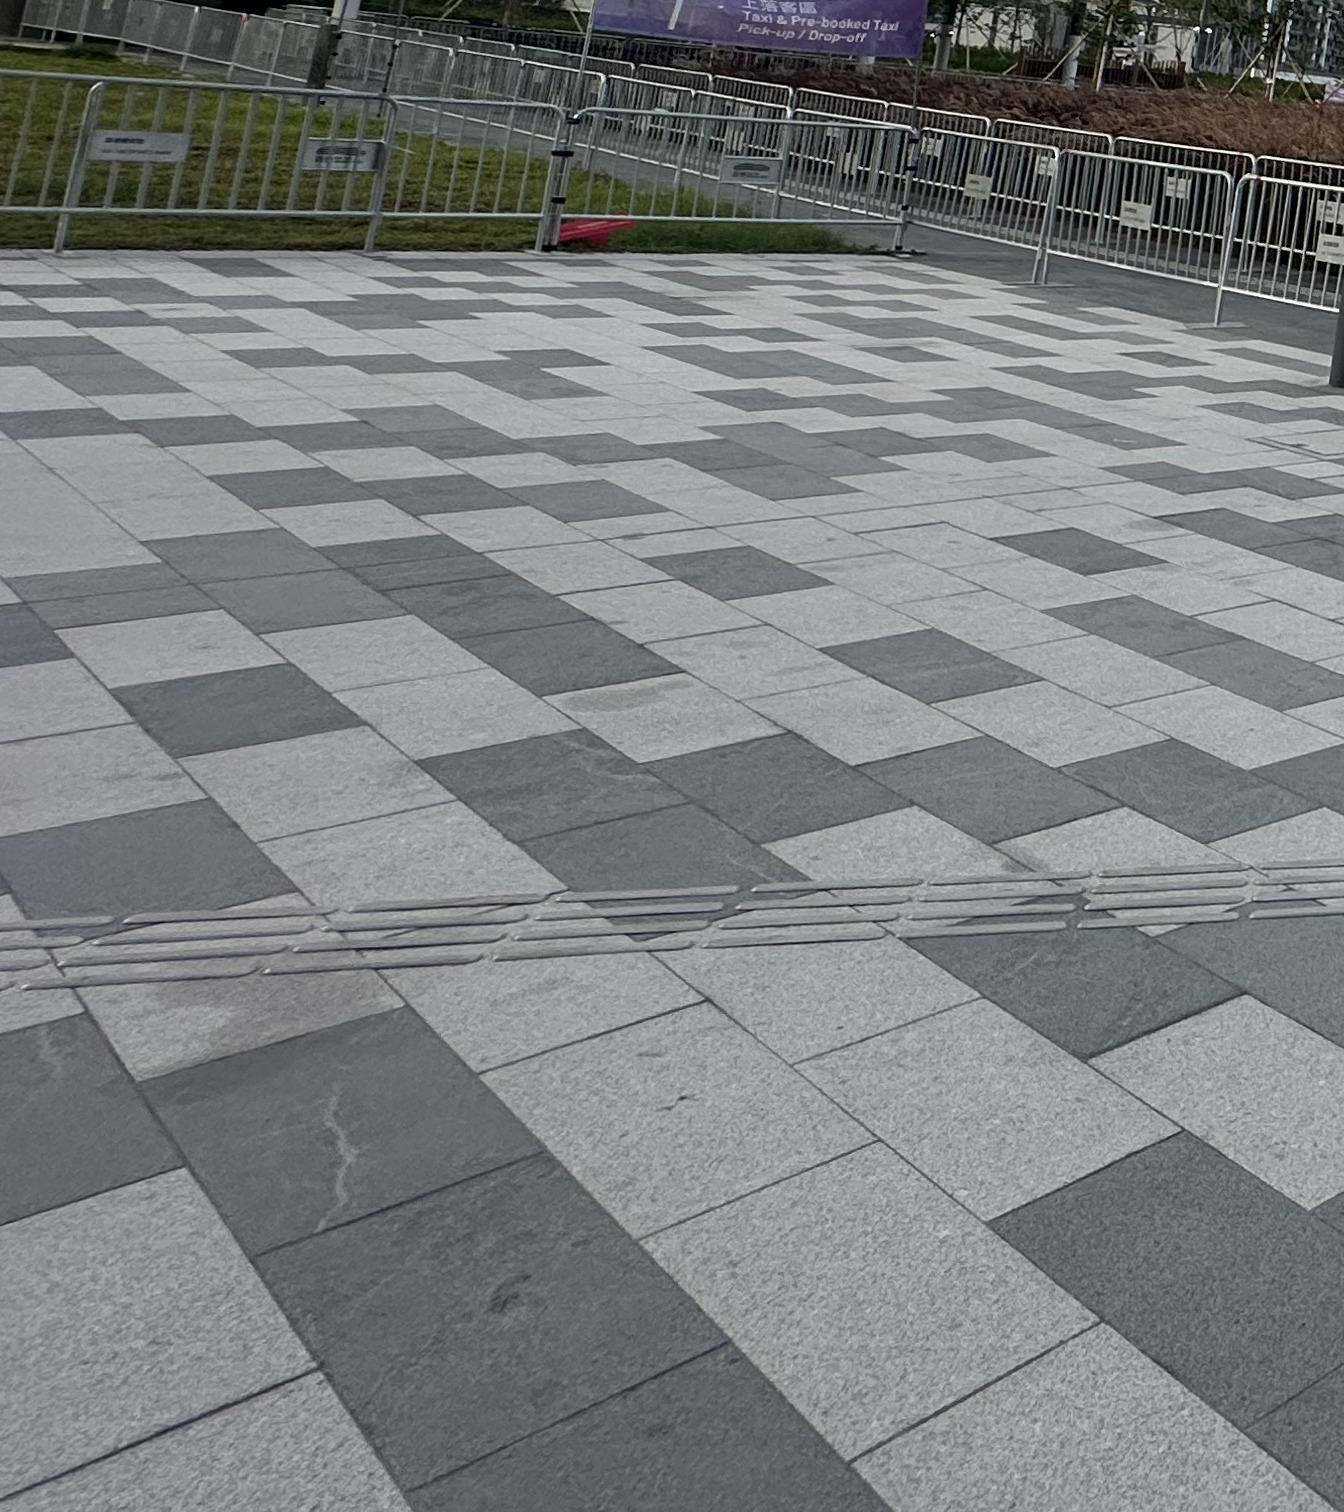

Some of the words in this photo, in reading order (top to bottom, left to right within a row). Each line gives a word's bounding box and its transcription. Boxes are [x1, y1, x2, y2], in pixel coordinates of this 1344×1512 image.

[741, 10, 773, 23] Taxi
[776, 15, 788, 25] &
[791, 15, 870, 31] Pre-booked
[873, 19, 900, 32] Taxi
[737, 23, 796, 40] Pick-up
[808, 29, 868, 44] Drop-off
